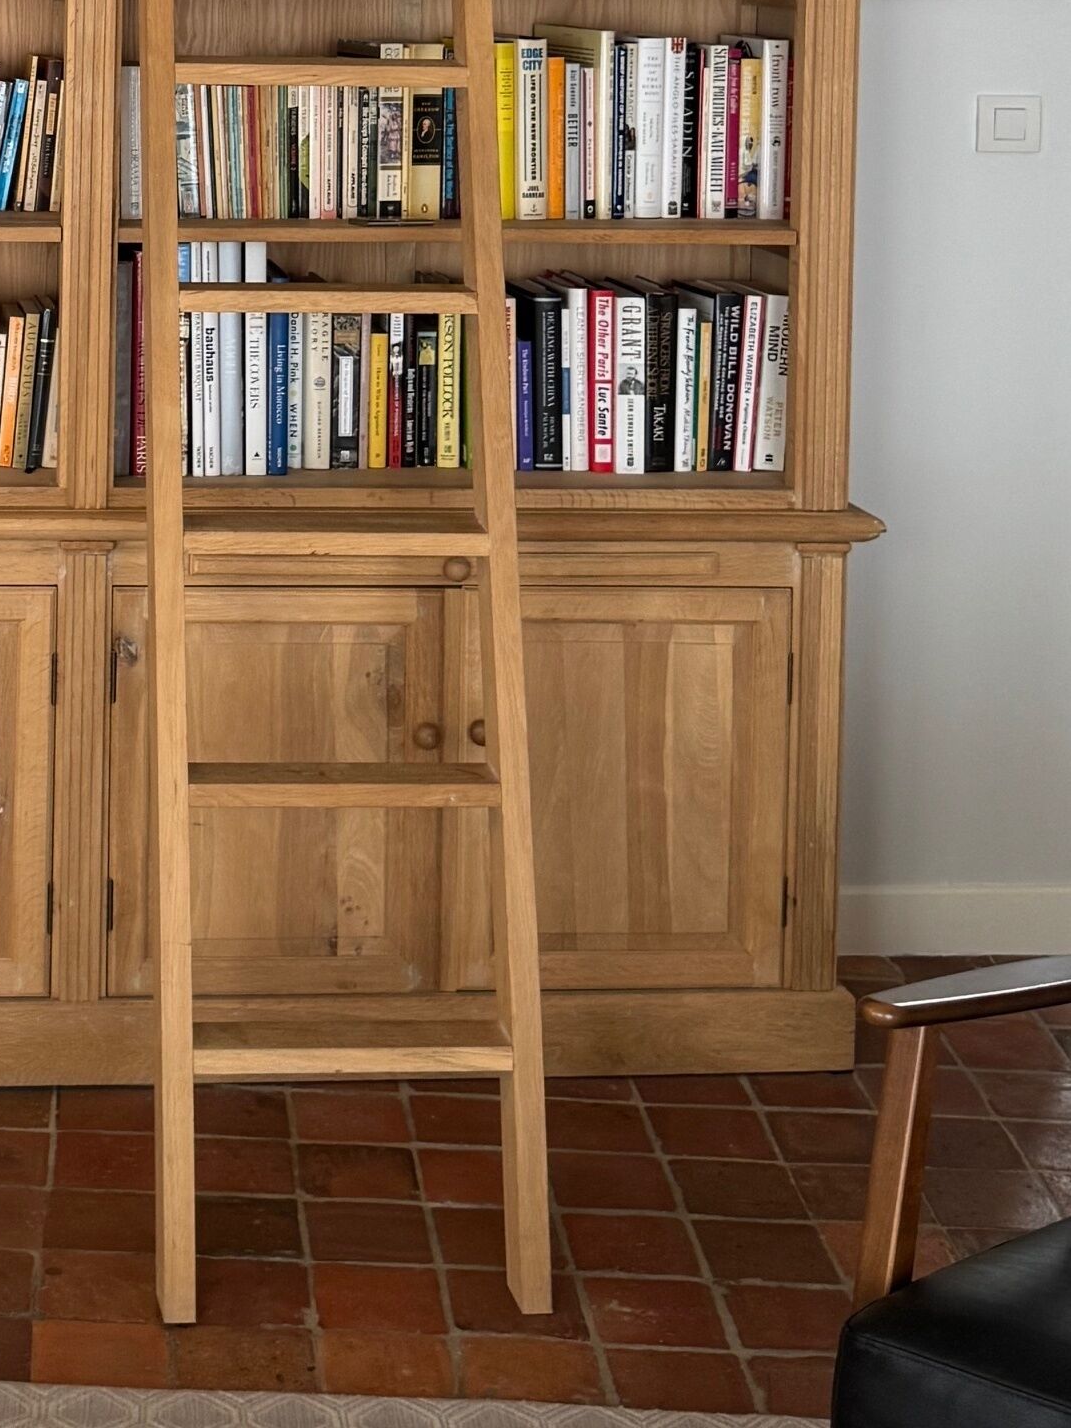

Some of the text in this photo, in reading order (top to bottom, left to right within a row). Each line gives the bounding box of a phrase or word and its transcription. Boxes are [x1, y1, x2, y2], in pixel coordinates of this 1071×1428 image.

[521, 49, 542, 58] EDGE
[522, 61, 542, 70] CITY
[713, 49, 726, 83] SEXUAL
[712, 86, 725, 126] POLITICS
[568, 114, 577, 147] BETTER
[712, 132, 723, 155] KATE
[205, 327, 215, 382] bauhaus
[275, 345, 285, 372] Living
[290, 348, 299, 359] H.
[744, 302, 758, 394] ELIZABETH WARREN
[768, 326, 778, 362] MIND
[276, 375, 284, 383] in
[290, 362, 299, 383] Pink
[442, 314, 454, 420] KSON POLLOCK
[597, 299, 609, 436] The Other Paris Luc Sante
[724, 306, 741, 450] WILD BILL DONOVAN
[250, 364, 259, 409] COVERS
[276, 386, 284, 424] Morocco
[653, 404, 665, 441] TAKAKI
[136, 436, 144, 473] PARIS
